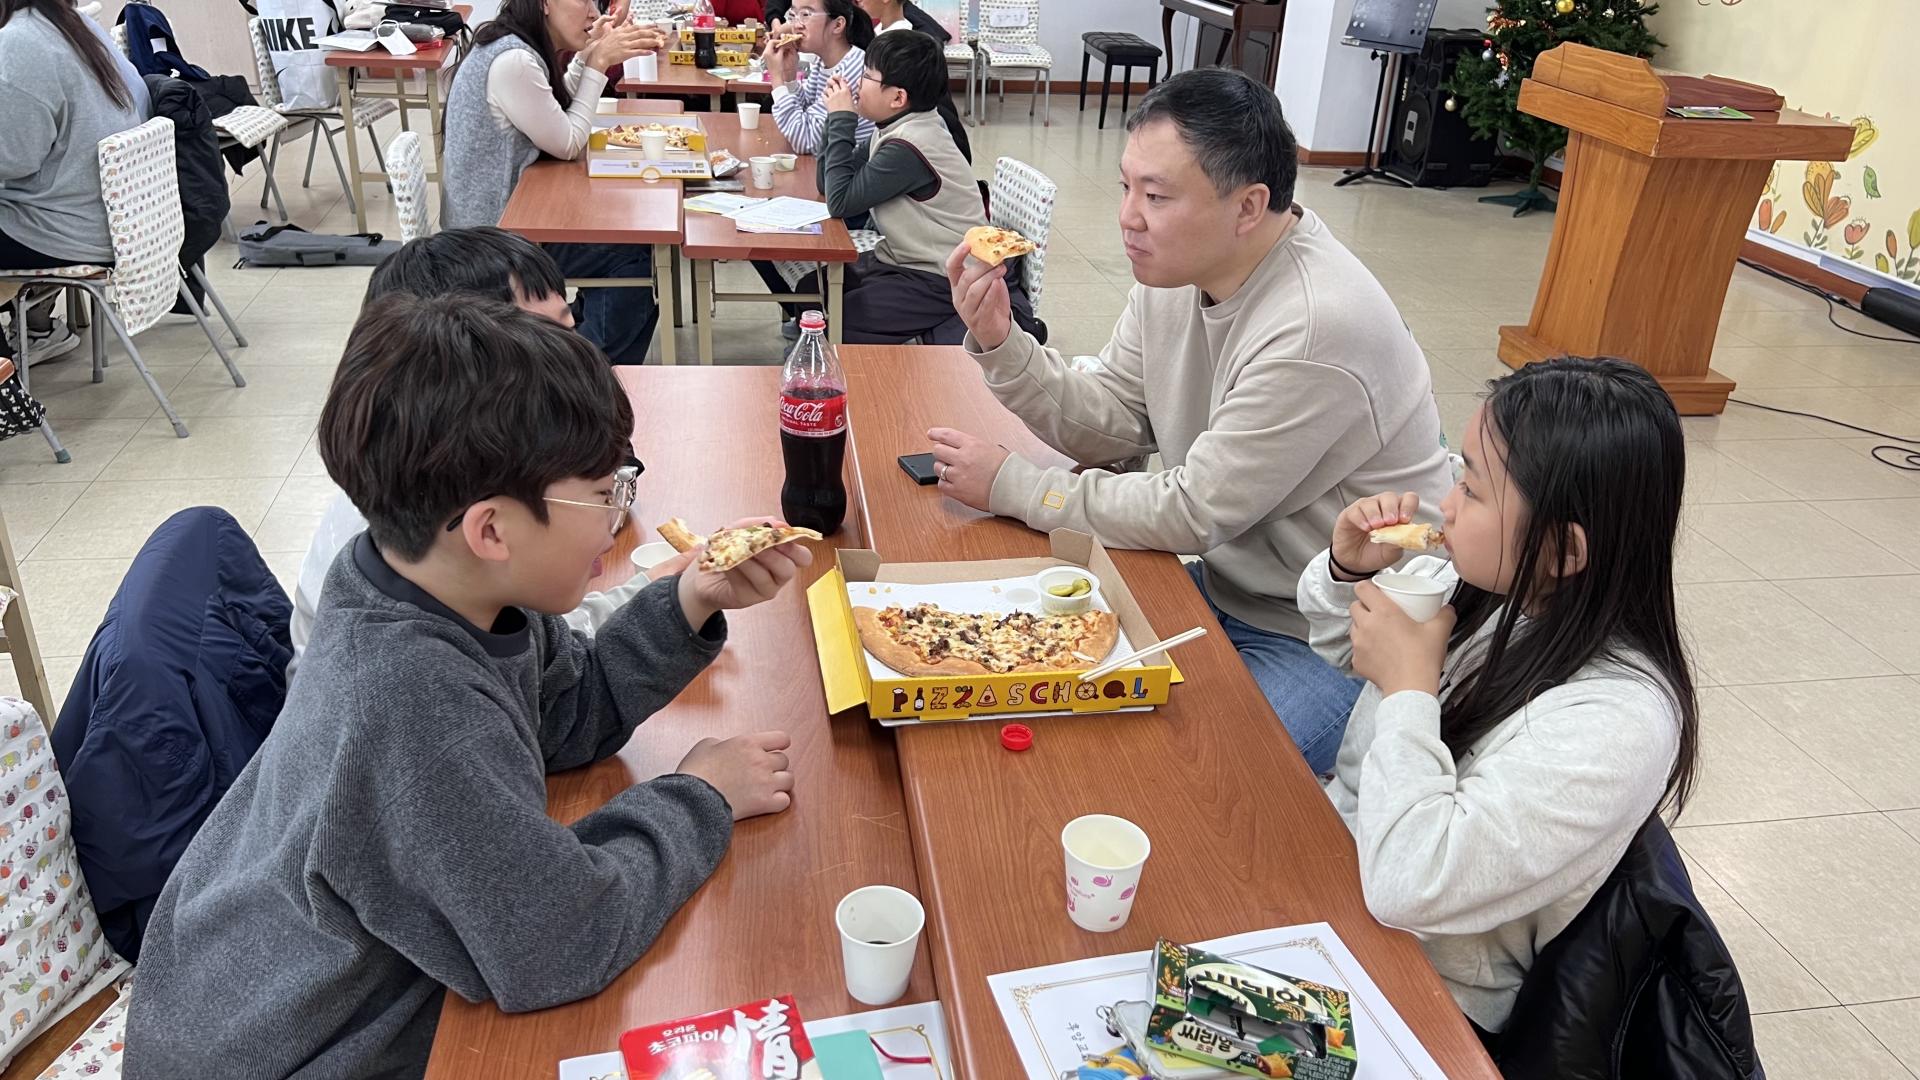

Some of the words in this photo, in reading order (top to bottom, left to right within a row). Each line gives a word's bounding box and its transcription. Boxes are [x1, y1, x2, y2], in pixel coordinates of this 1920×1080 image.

[892, 683, 998, 713] PIZZA
[1006, 676, 1149, 706] SCHOOL
[648, 1028, 719, 1056] 초코파이
[721, 998, 799, 1079] 情
[1178, 1023, 1233, 1053] 씨리얼
